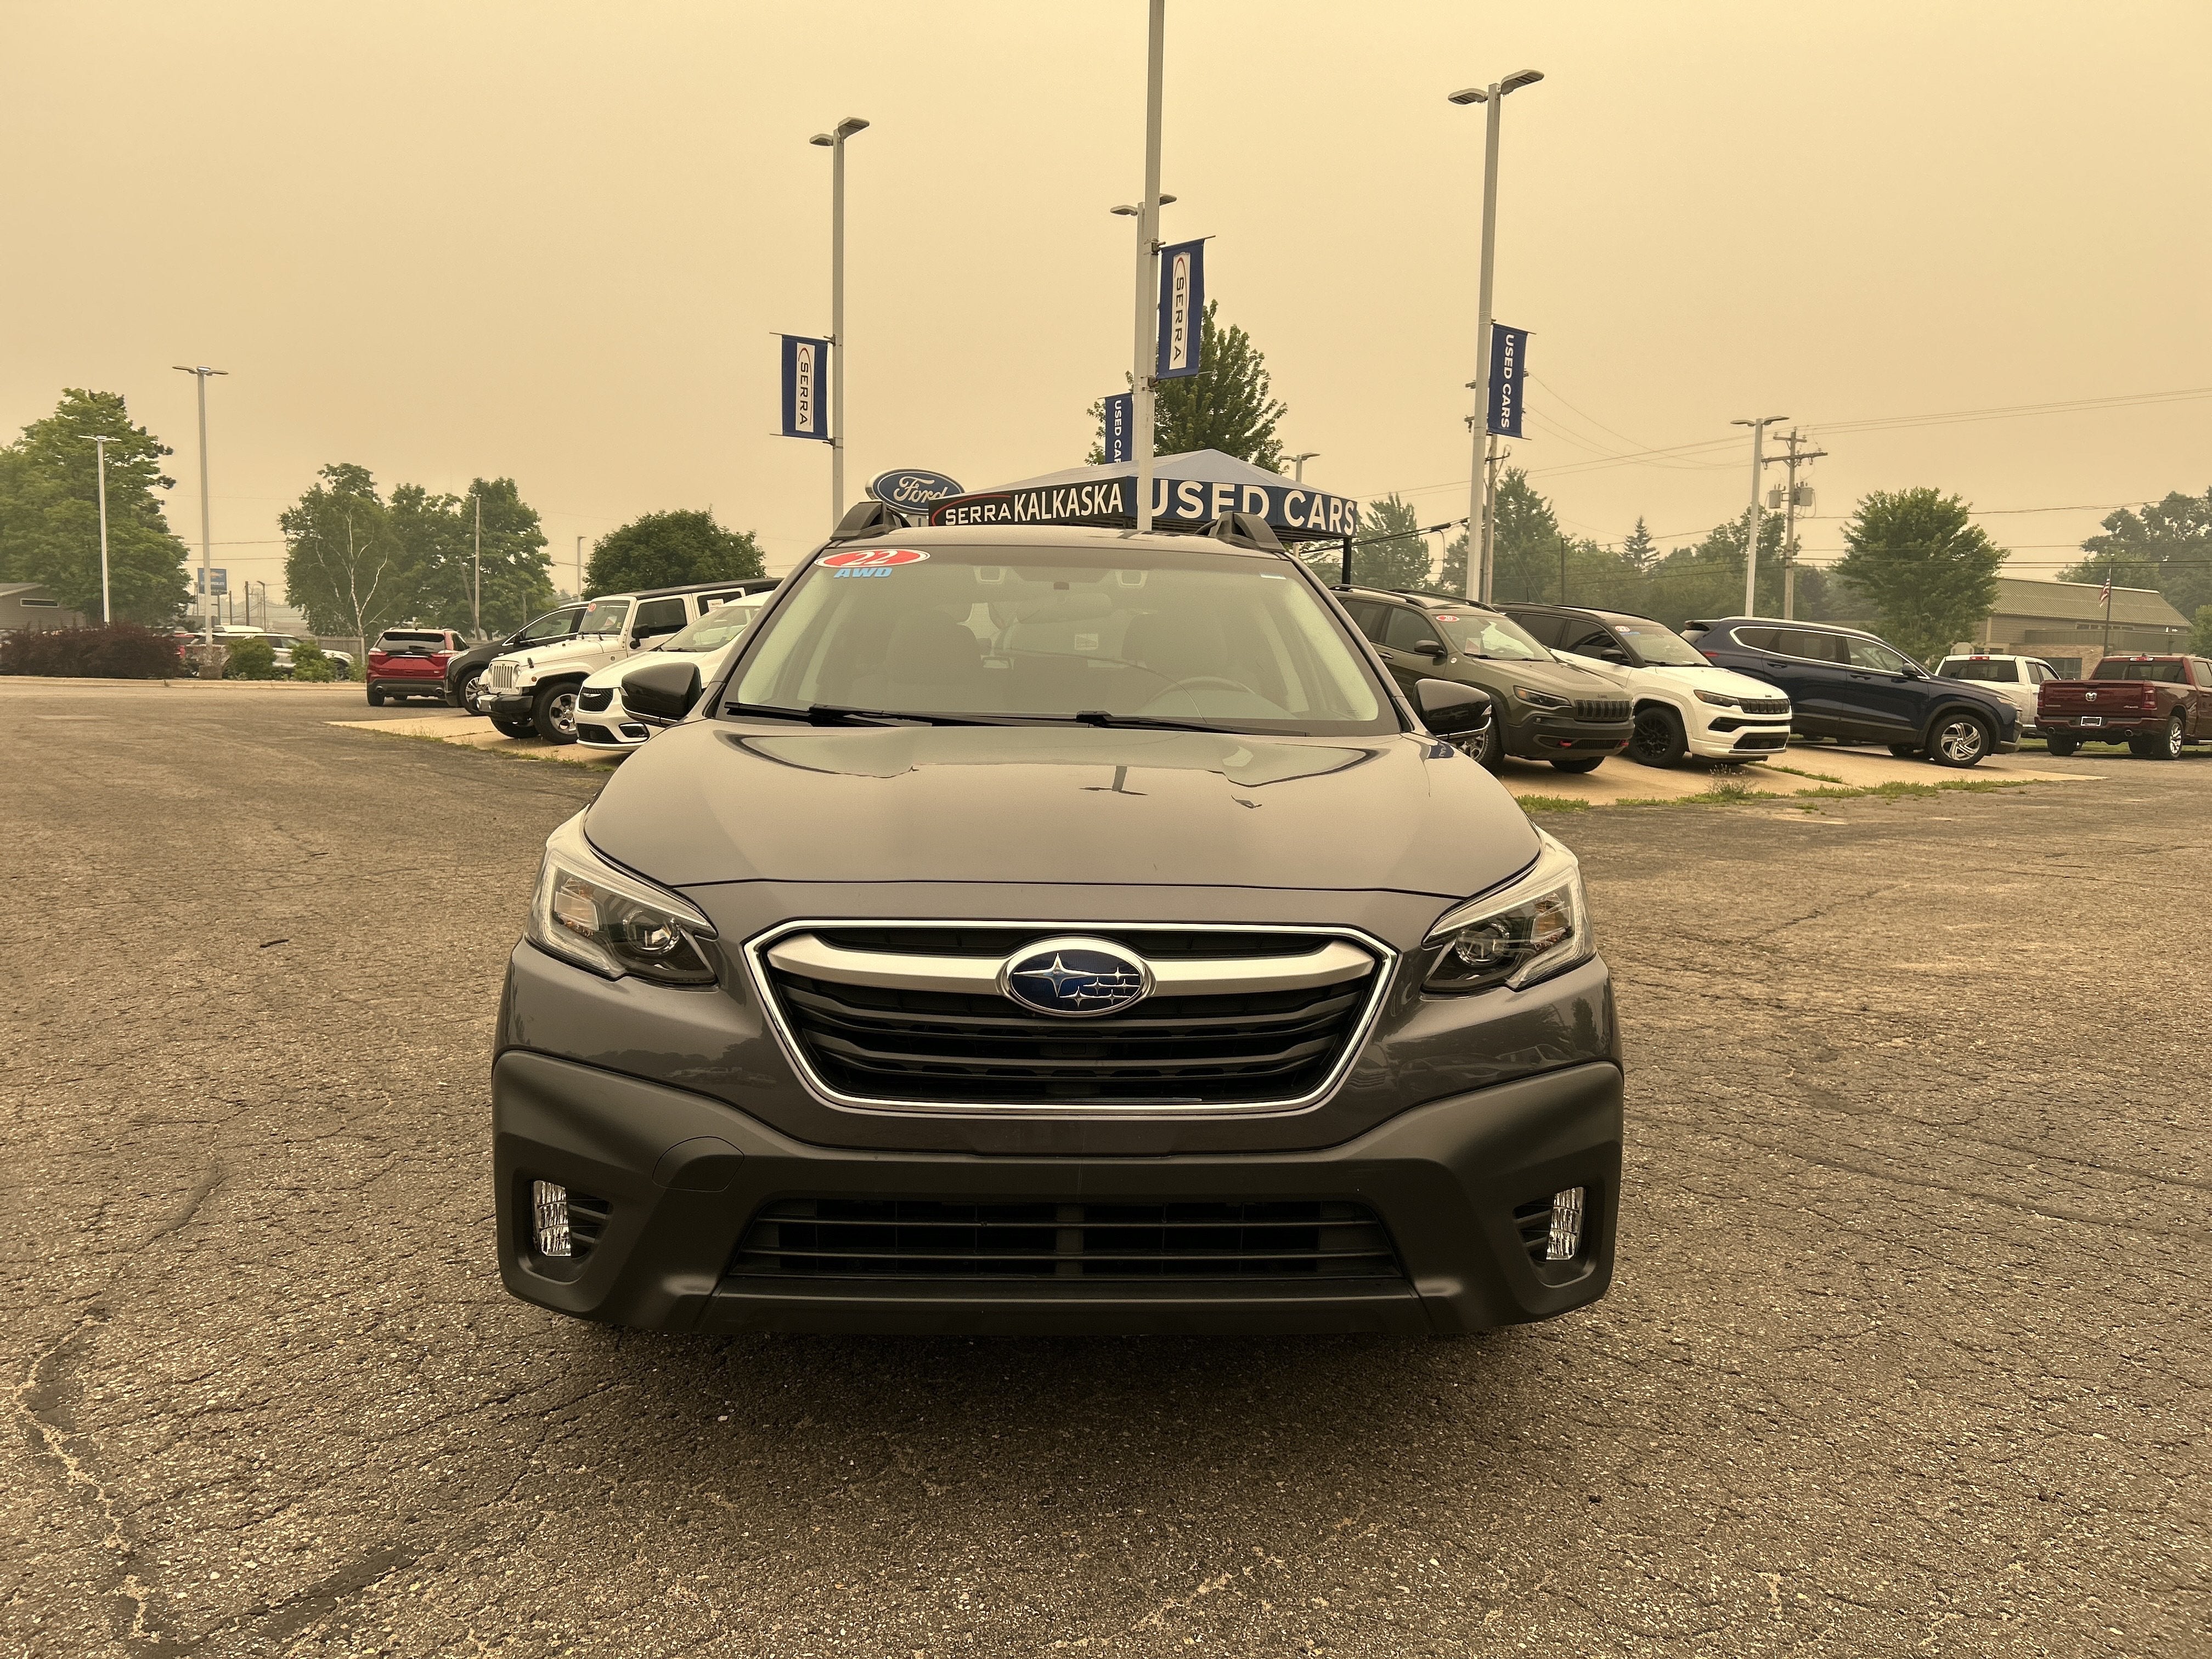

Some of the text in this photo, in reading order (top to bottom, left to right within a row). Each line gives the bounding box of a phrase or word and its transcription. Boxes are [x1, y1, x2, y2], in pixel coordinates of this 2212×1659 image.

[1173, 276, 1184, 361] SERRA
[800, 362, 809, 425] SERRA
[1501, 334, 1514, 428] USED CARS
[945, 483, 1124, 526] SERRA KALKASKA
[1283, 490, 1355, 536] CARS
[833, 567, 893, 579] AWD
[840, 550, 899, 567] 22
